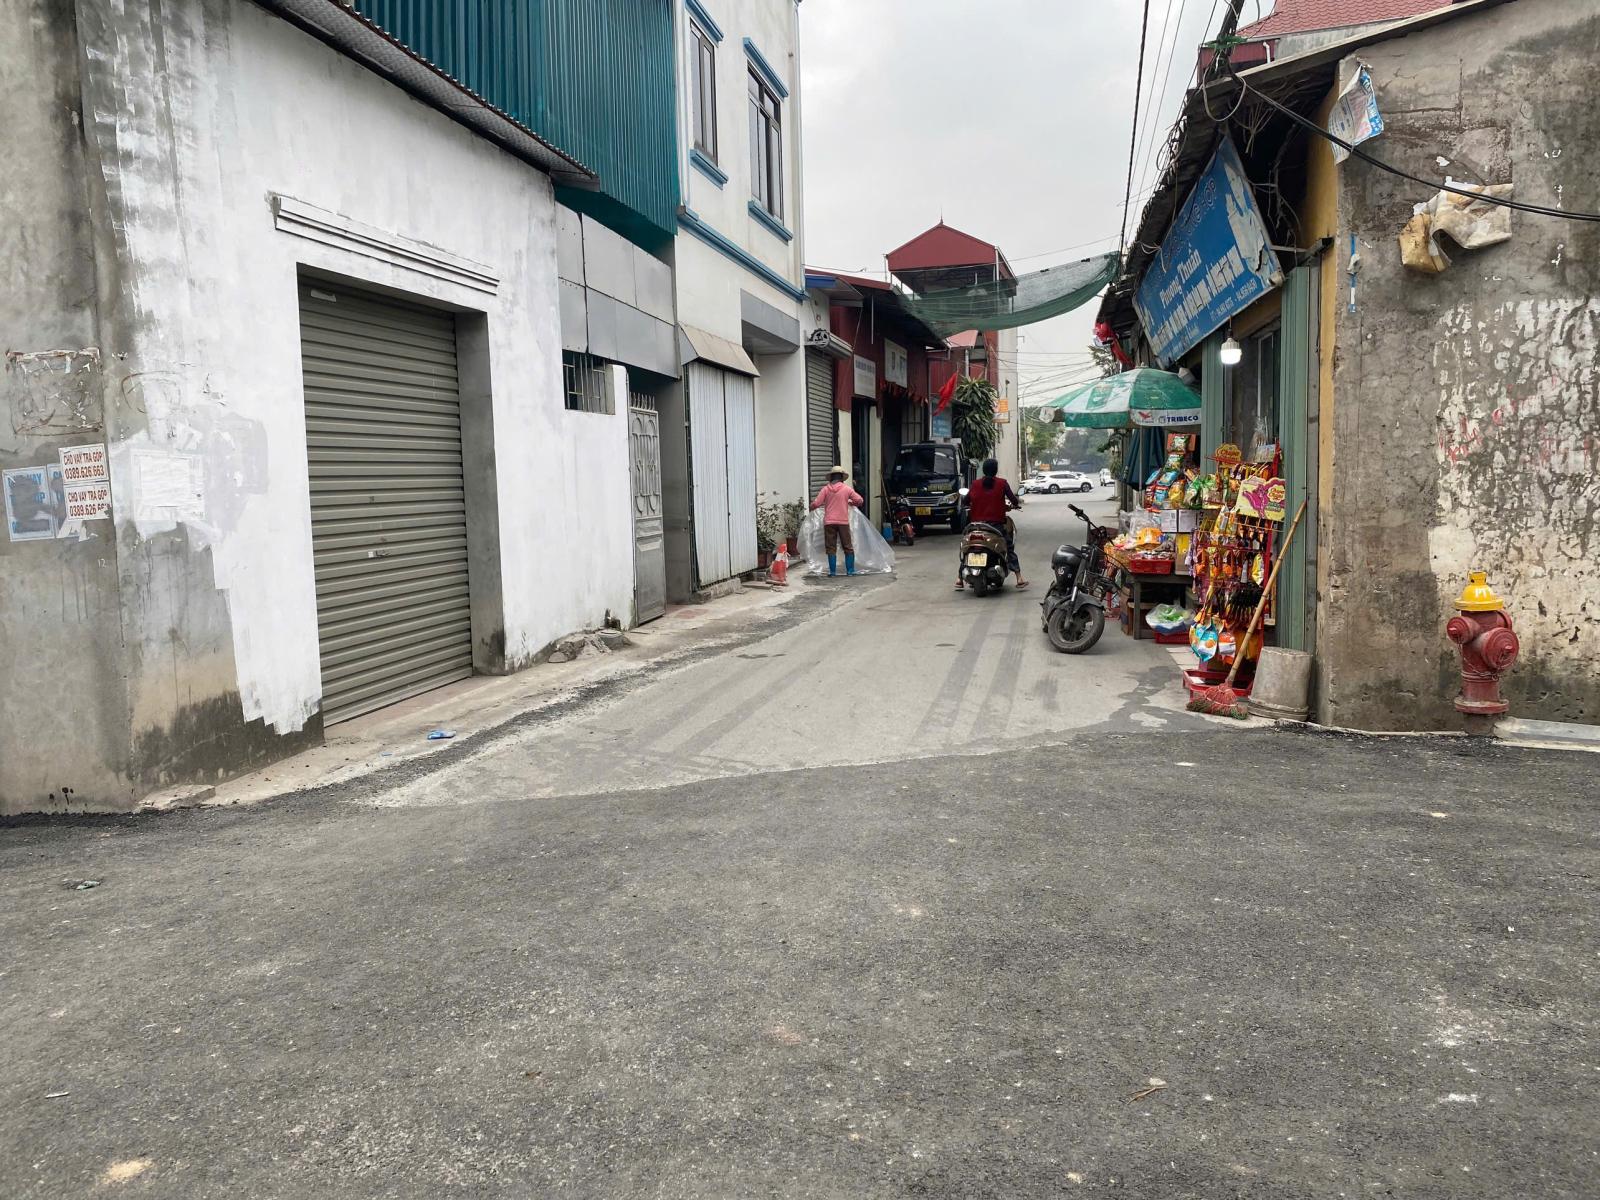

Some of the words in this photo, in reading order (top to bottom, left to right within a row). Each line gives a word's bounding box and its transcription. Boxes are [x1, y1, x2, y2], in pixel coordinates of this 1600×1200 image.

[63, 454, 74, 465] CHO
[73, 453, 83, 464] VAY
[68, 491, 78, 503] CHO
[78, 491, 87, 501] VAY
